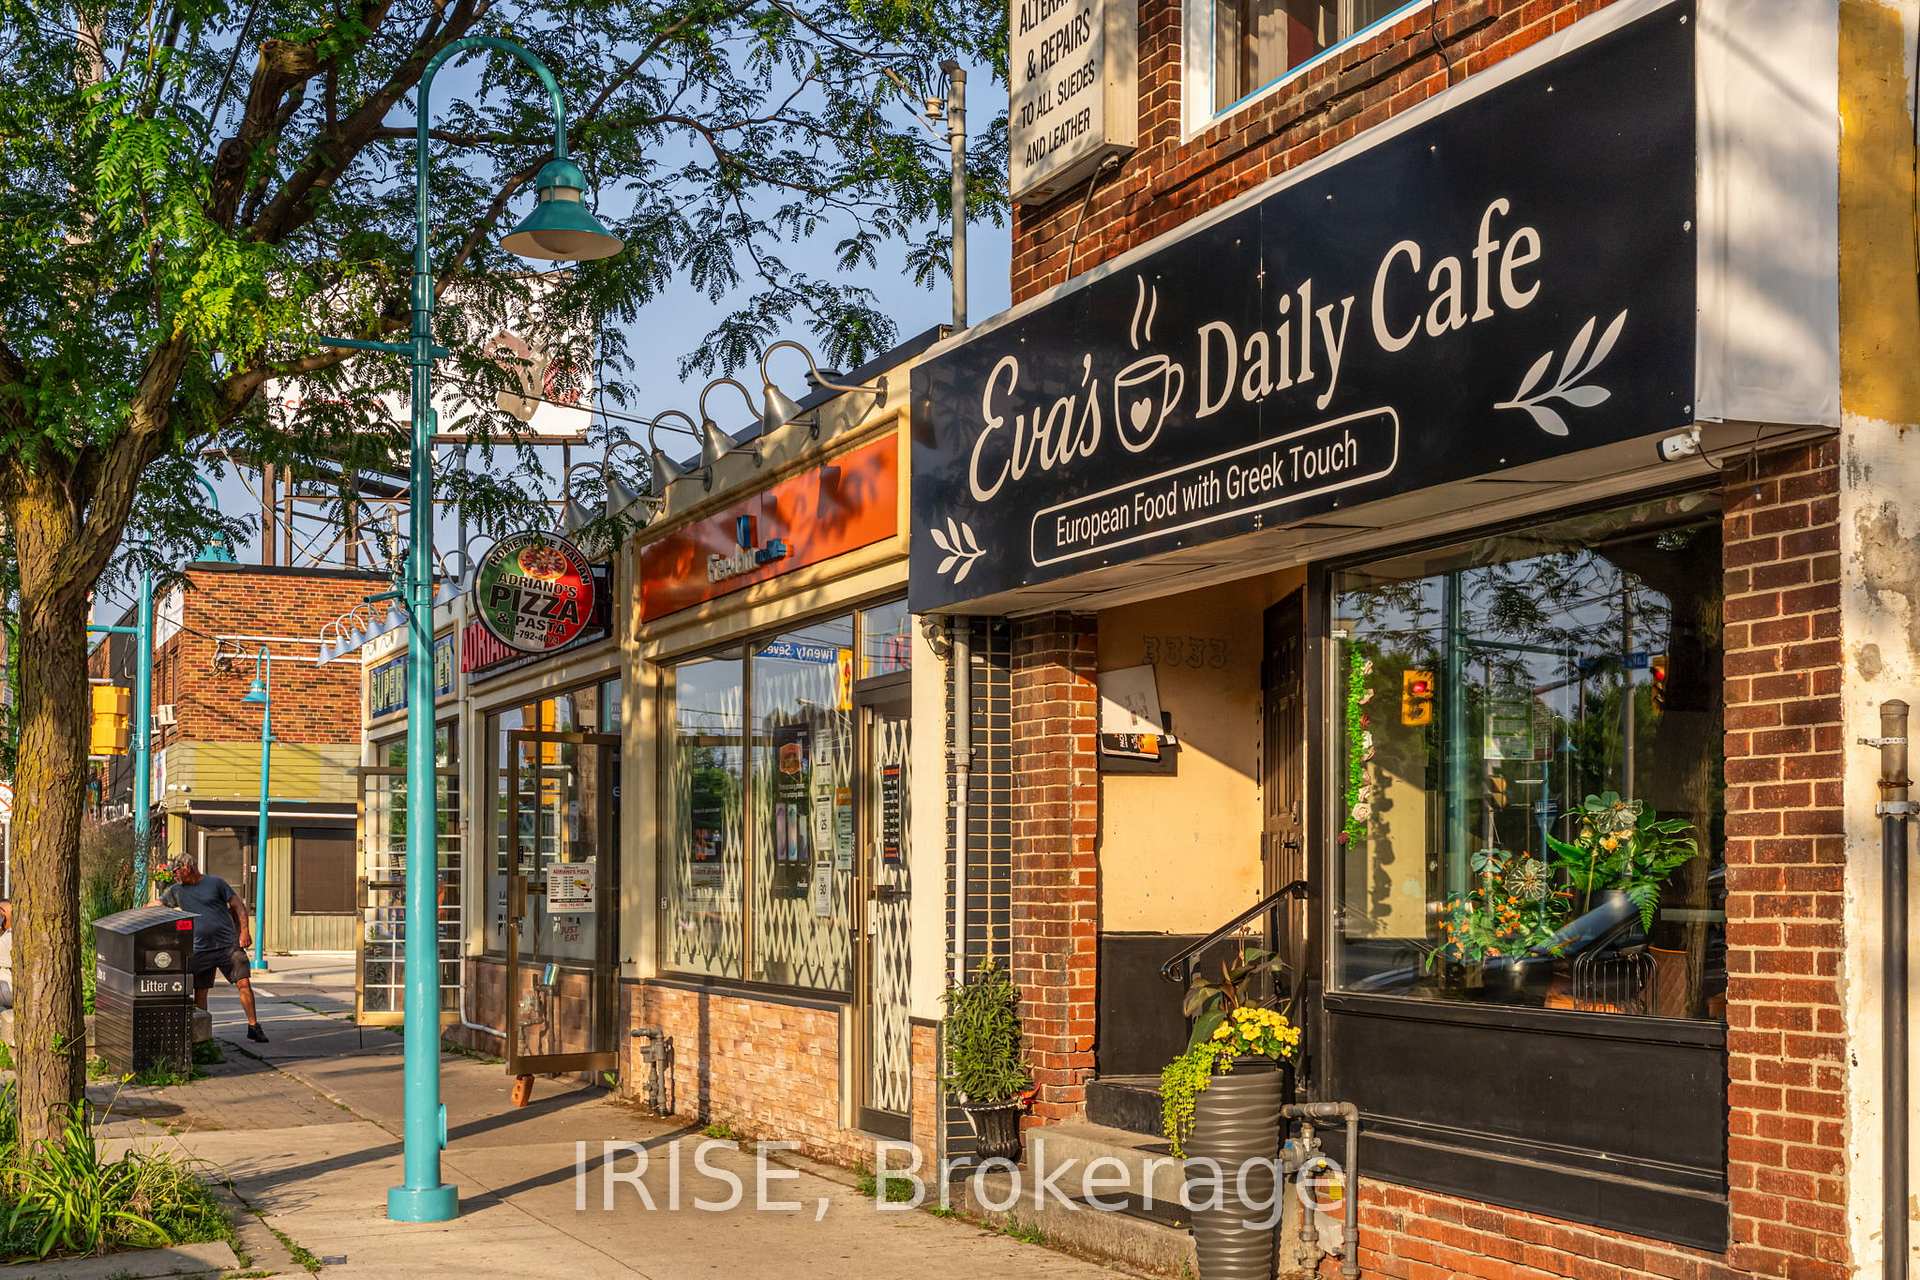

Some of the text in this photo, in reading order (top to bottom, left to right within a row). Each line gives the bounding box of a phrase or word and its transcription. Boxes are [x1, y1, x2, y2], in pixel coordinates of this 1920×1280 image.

[1026, 7, 1090, 82] & REPAIRS
[1021, 59, 1095, 129] TO ALL SUEDES
[1026, 107, 1091, 169] AND LEATHER
[968, 197, 1542, 503] Eva's Daily Cafe
[1056, 429, 1358, 547] European Food with Greek Touch
[489, 535, 591, 586] HOME MDE ITALIAN
[498, 572, 577, 598] ADRIANO'S
[489, 584, 580, 625] PIZZA
[495, 611, 567, 635] & PASTA
[140, 979, 168, 993] Litter
